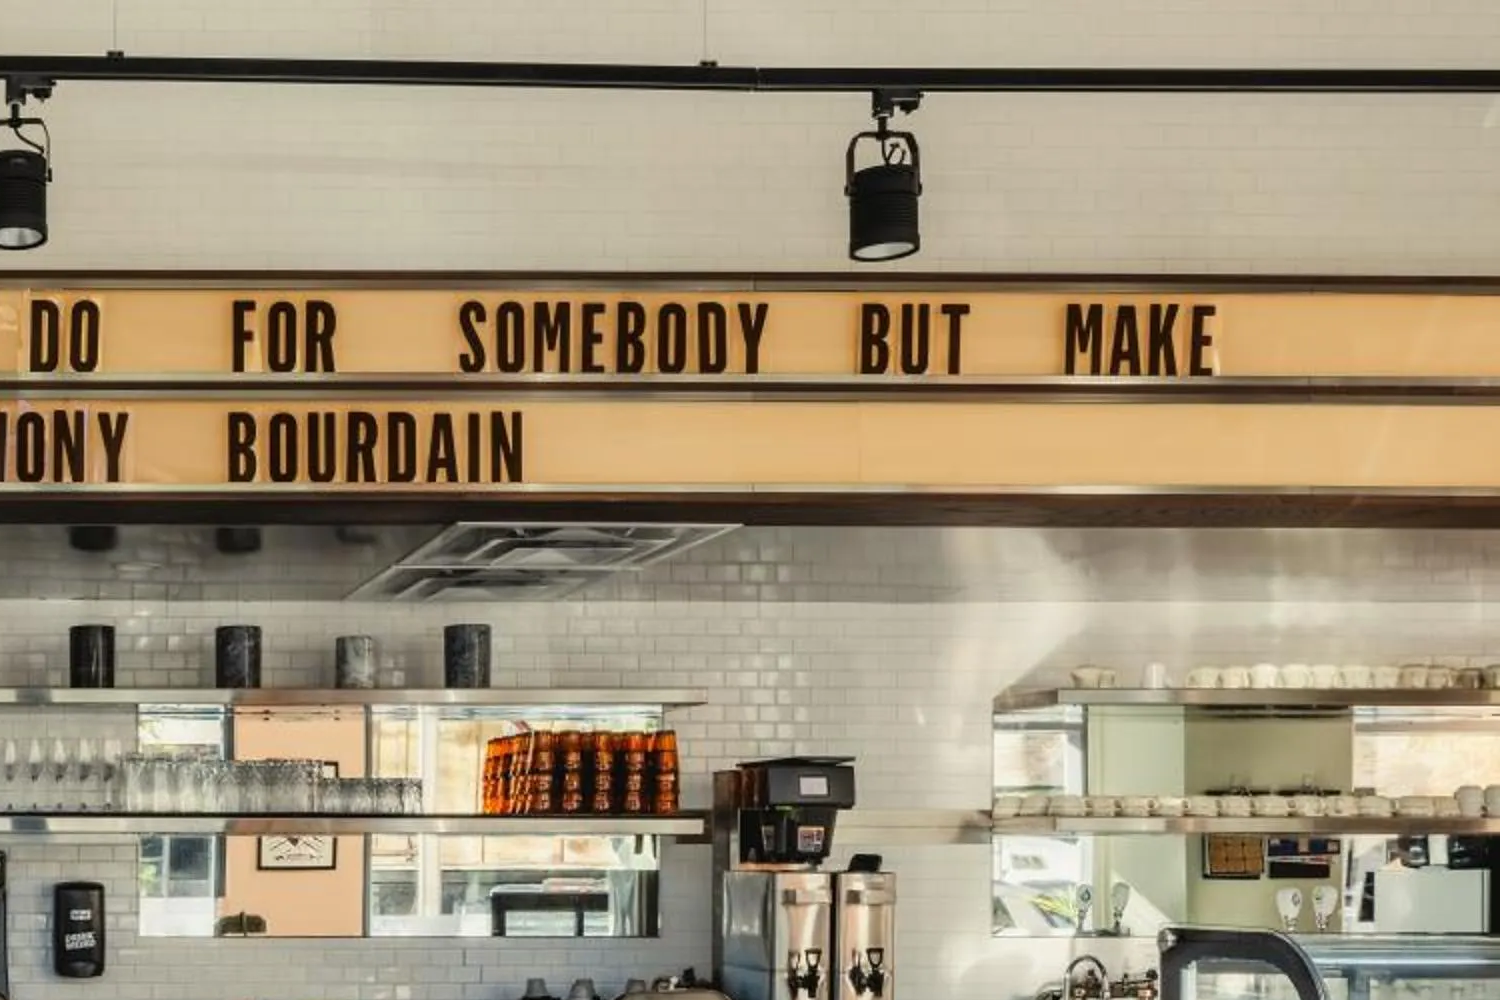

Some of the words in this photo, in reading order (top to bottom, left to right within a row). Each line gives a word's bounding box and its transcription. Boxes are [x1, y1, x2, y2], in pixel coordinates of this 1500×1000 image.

[29, 300, 100, 372] DO
[232, 300, 337, 373] FOR
[458, 301, 769, 374] SOMEBODY
[859, 303, 971, 375] BUT
[1064, 304, 1217, 376] MAKE
[227, 411, 523, 483] BOURDAIN
